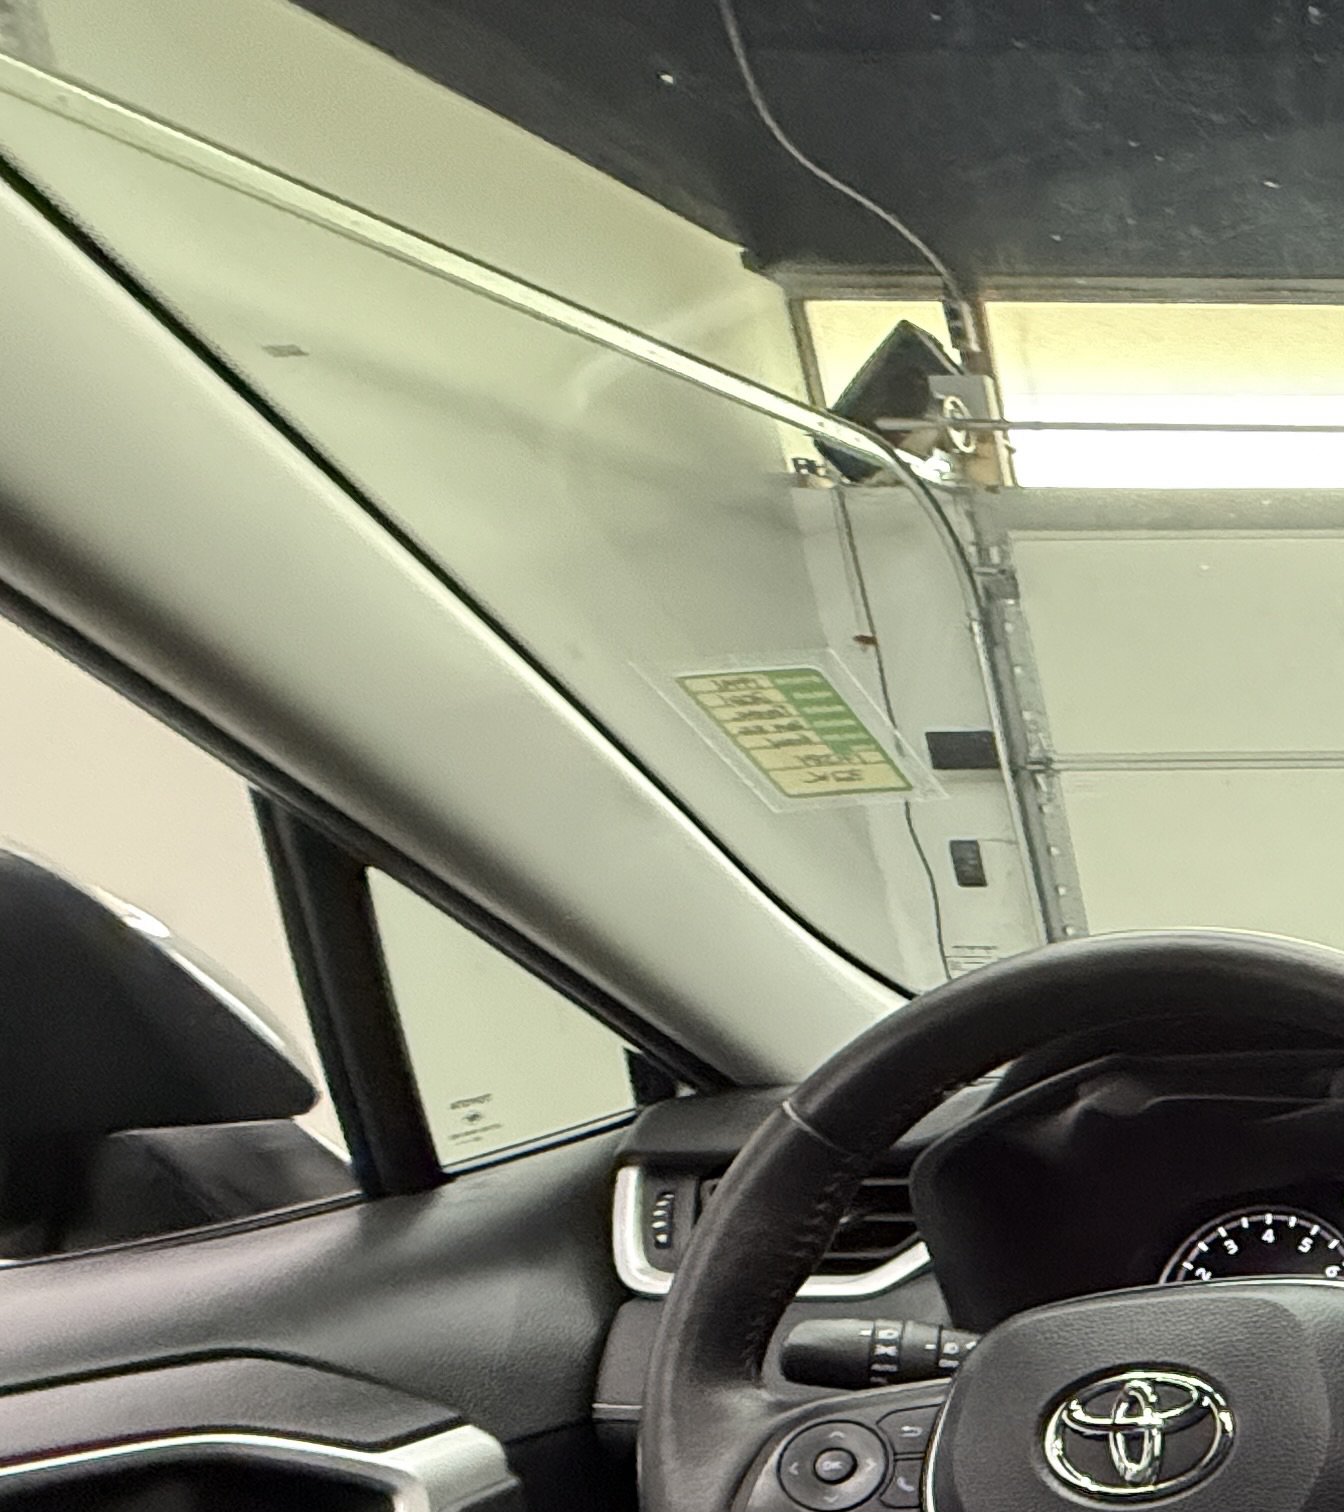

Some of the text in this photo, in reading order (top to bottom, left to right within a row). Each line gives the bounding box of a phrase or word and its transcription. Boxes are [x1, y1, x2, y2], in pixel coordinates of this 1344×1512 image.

[1261, 1228, 1276, 1244] 4
[1223, 1238, 1239, 1255] 3
[1298, 1237, 1314, 1254] 5
[1325, 1264, 1342, 1279] 6
[821, 1460, 843, 1471] OK
